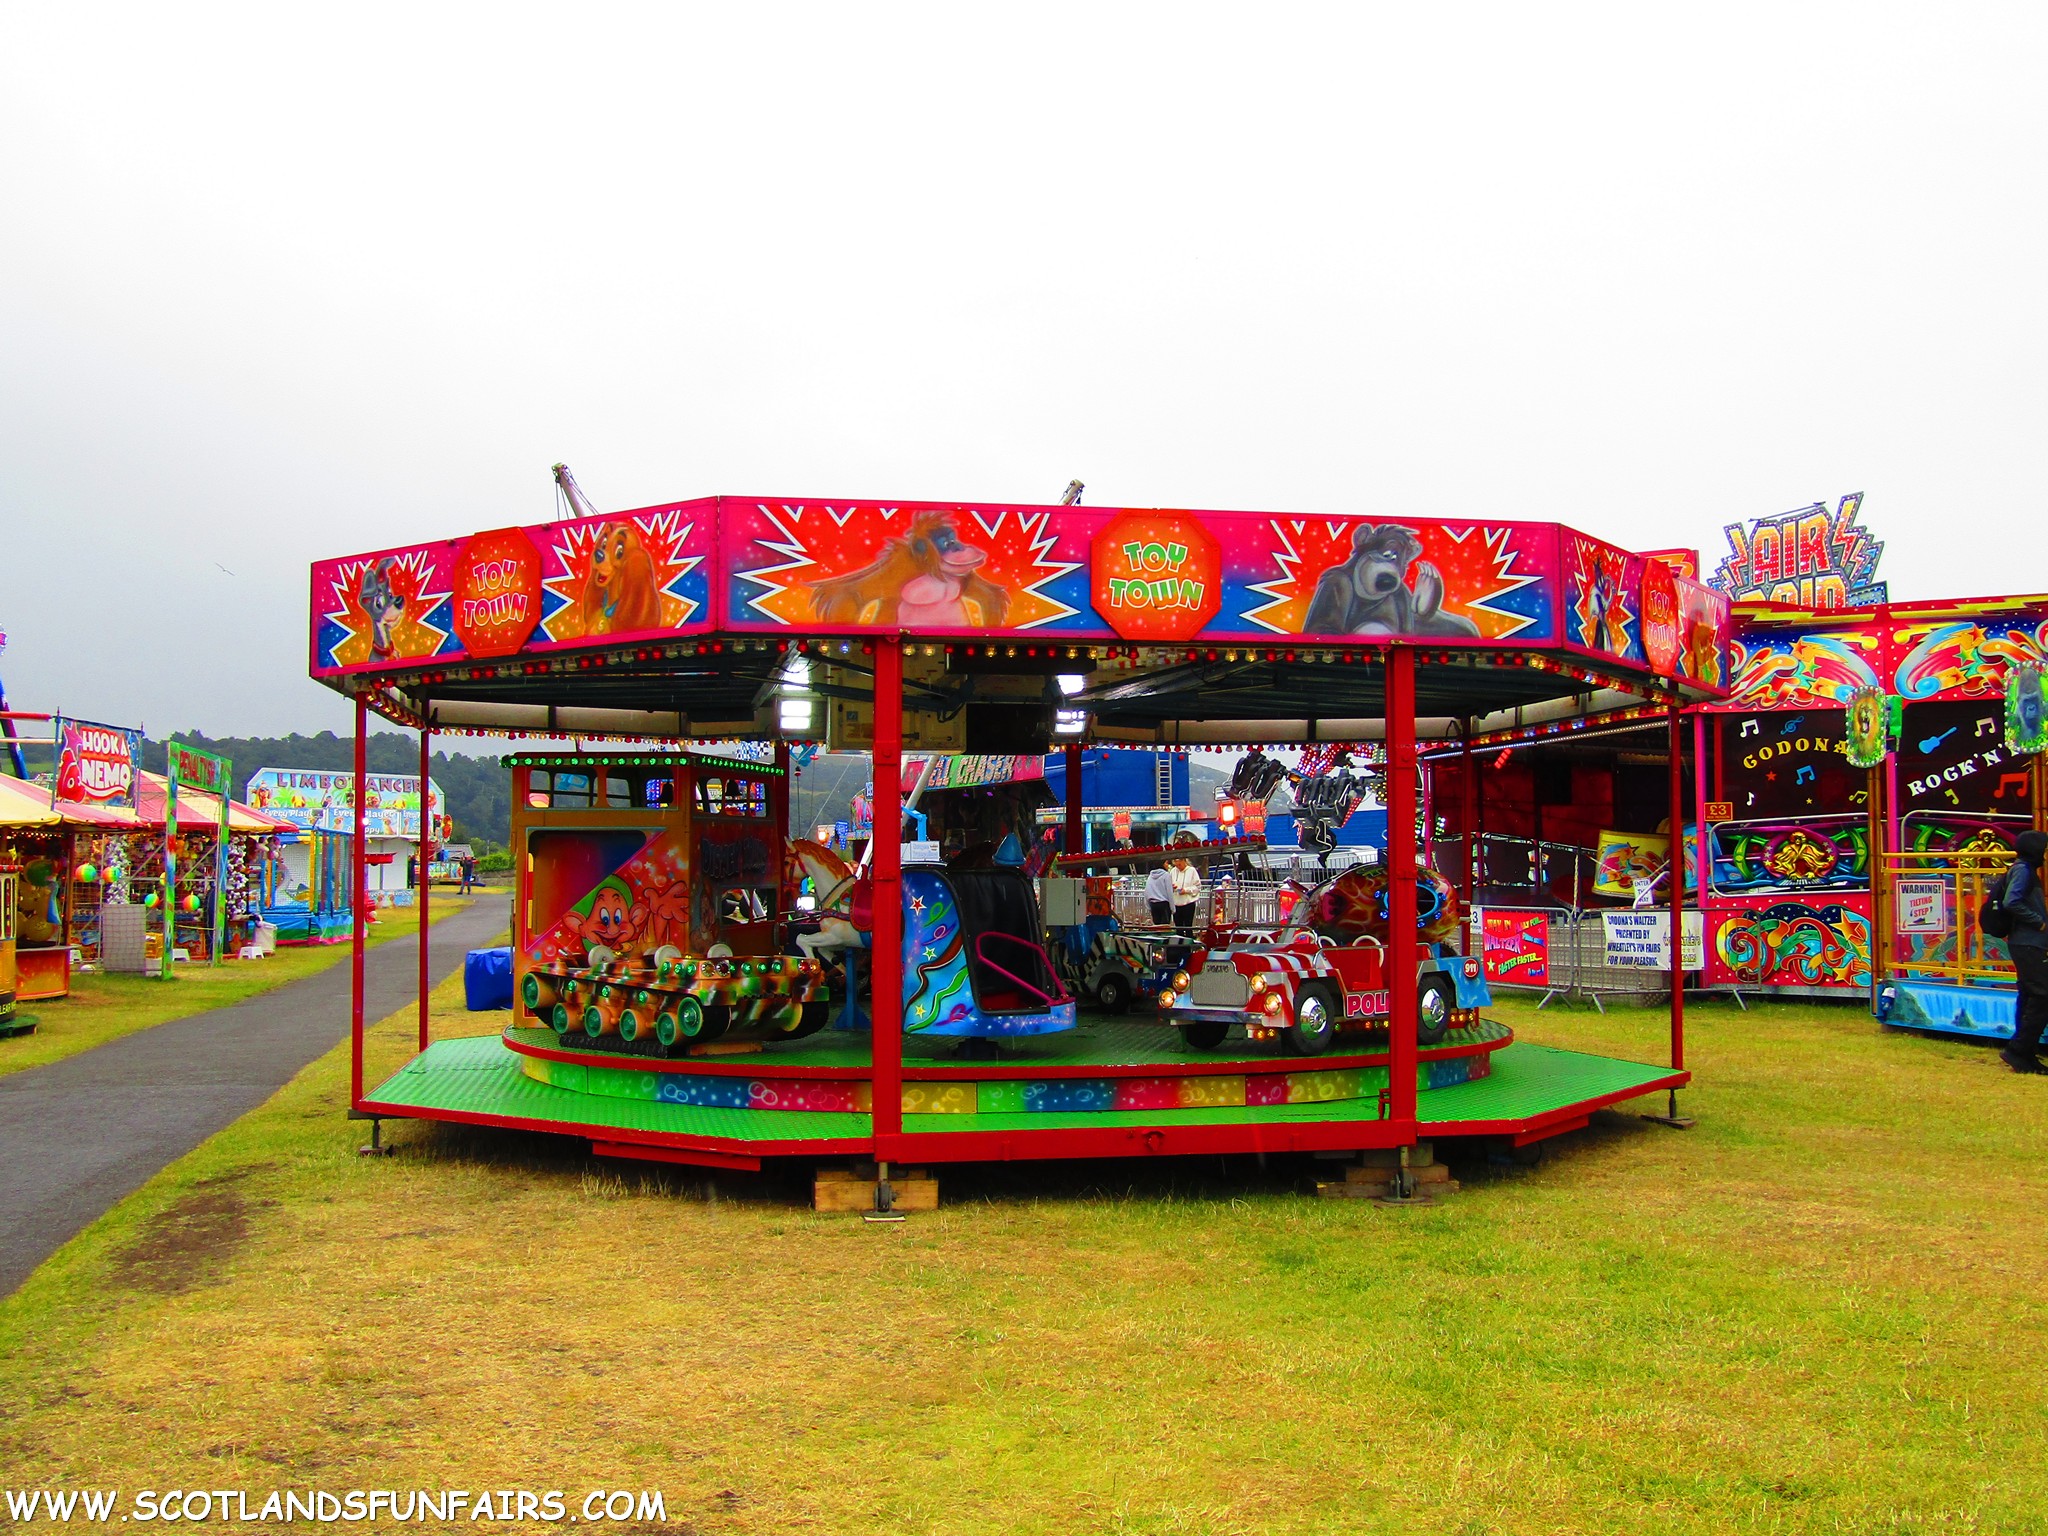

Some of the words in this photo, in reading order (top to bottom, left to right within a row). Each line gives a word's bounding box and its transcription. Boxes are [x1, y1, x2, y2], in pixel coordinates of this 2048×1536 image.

[1123, 541, 1188, 573] TOY
[1752, 512, 1831, 585] AIR
[473, 559, 517, 592] TOY
[1109, 578, 1205, 611] TOWN
[1650, 589, 1670, 620] TOY
[463, 593, 528, 628] TOWN
[1646, 619, 1677, 654] TOWN
[82, 730, 119, 754] HOOK
[119, 741, 129, 757] A
[82, 759, 132, 789] NEMO
[956, 755, 1016, 785] CHASER
[277, 772, 348, 789] LIMBO
[352, 776, 421, 793] ANCER
[333, 809, 354, 817] Ever
[1710, 804, 1727, 816] £3
[1634, 879, 1649, 887] ENTER
[1901, 884, 1941, 894] WARNING!
[1471, 911, 1479, 924] 3
[1634, 916, 1657, 925] WALTZER
[1913, 907, 1930, 918] STEP
[1483, 932, 1521, 954] WALTZER
[1643, 930, 1650, 939] BY
[1607, 942, 1637, 953] WHEATLEY'S
[1645, 943, 1661, 953] FAIRS
[1465, 963, 1477, 973] 911
[1498, 957, 1518, 976] FASTER
[1607, 955, 1618, 965] FOR
[1619, 956, 1633, 965] YOUR
